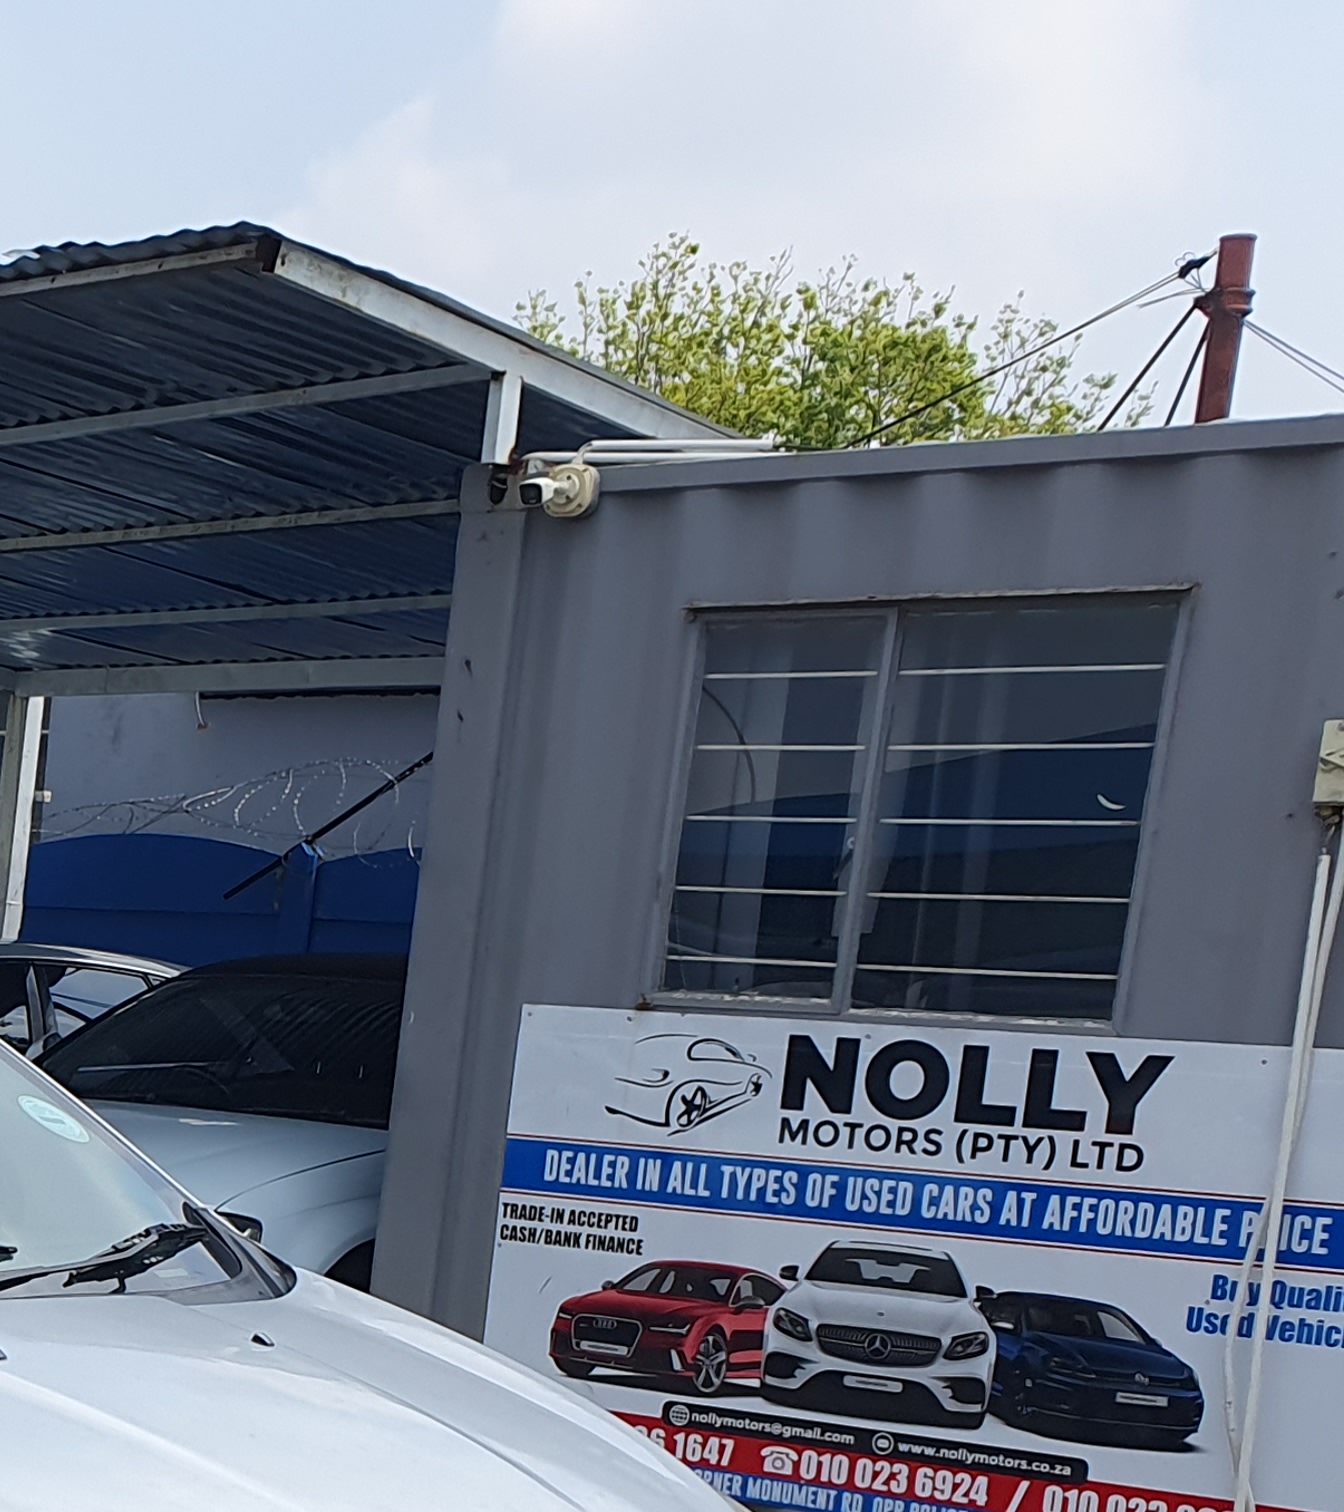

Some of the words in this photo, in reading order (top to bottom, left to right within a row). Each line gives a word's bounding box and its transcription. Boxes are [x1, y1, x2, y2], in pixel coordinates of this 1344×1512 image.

[780, 1033, 1175, 1136] NOLLY
[778, 1116, 944, 1157] MOTORS
[955, 1129, 1057, 1171] (PTY)
[1070, 1139, 1145, 1173] LTD
[502, 1202, 565, 1226] TRADE-IN
[567, 1209, 639, 1233] ACCEPTED
[543, 1149, 629, 1190] DEALER
[636, 1157, 662, 1193] IN
[666, 1161, 711, 1198] ALL
[720, 1165, 799, 1206] TYPES
[804, 1172, 840, 1209] OF
[845, 1176, 913, 1217] USED
[921, 1183, 994, 1225] CARS
[998, 1189, 1037, 1229] AT
[1042, 1194, 1231, 1247] AFFORDABLE
[1238, 1210, 1334, 1256] PICE
[499, 1224, 582, 1250] CASH/BANK
[585, 1233, 644, 1257] FINANCE
[1269, 1279, 1344, 1313] Quali
[1265, 1314, 1344, 1350] Vehic
[691, 1410, 855, 1445] nollymotors@gmail.com
[897, 1441, 1072, 1477] www.nollymotors.co.za
[672, 1431, 735, 1467] 1647
[799, 1449, 850, 1486] 010
[854, 1457, 909, 1494] 023
[914, 1466, 989, 1507] 6924
[745, 1477, 838, 1512] MONUMENT
